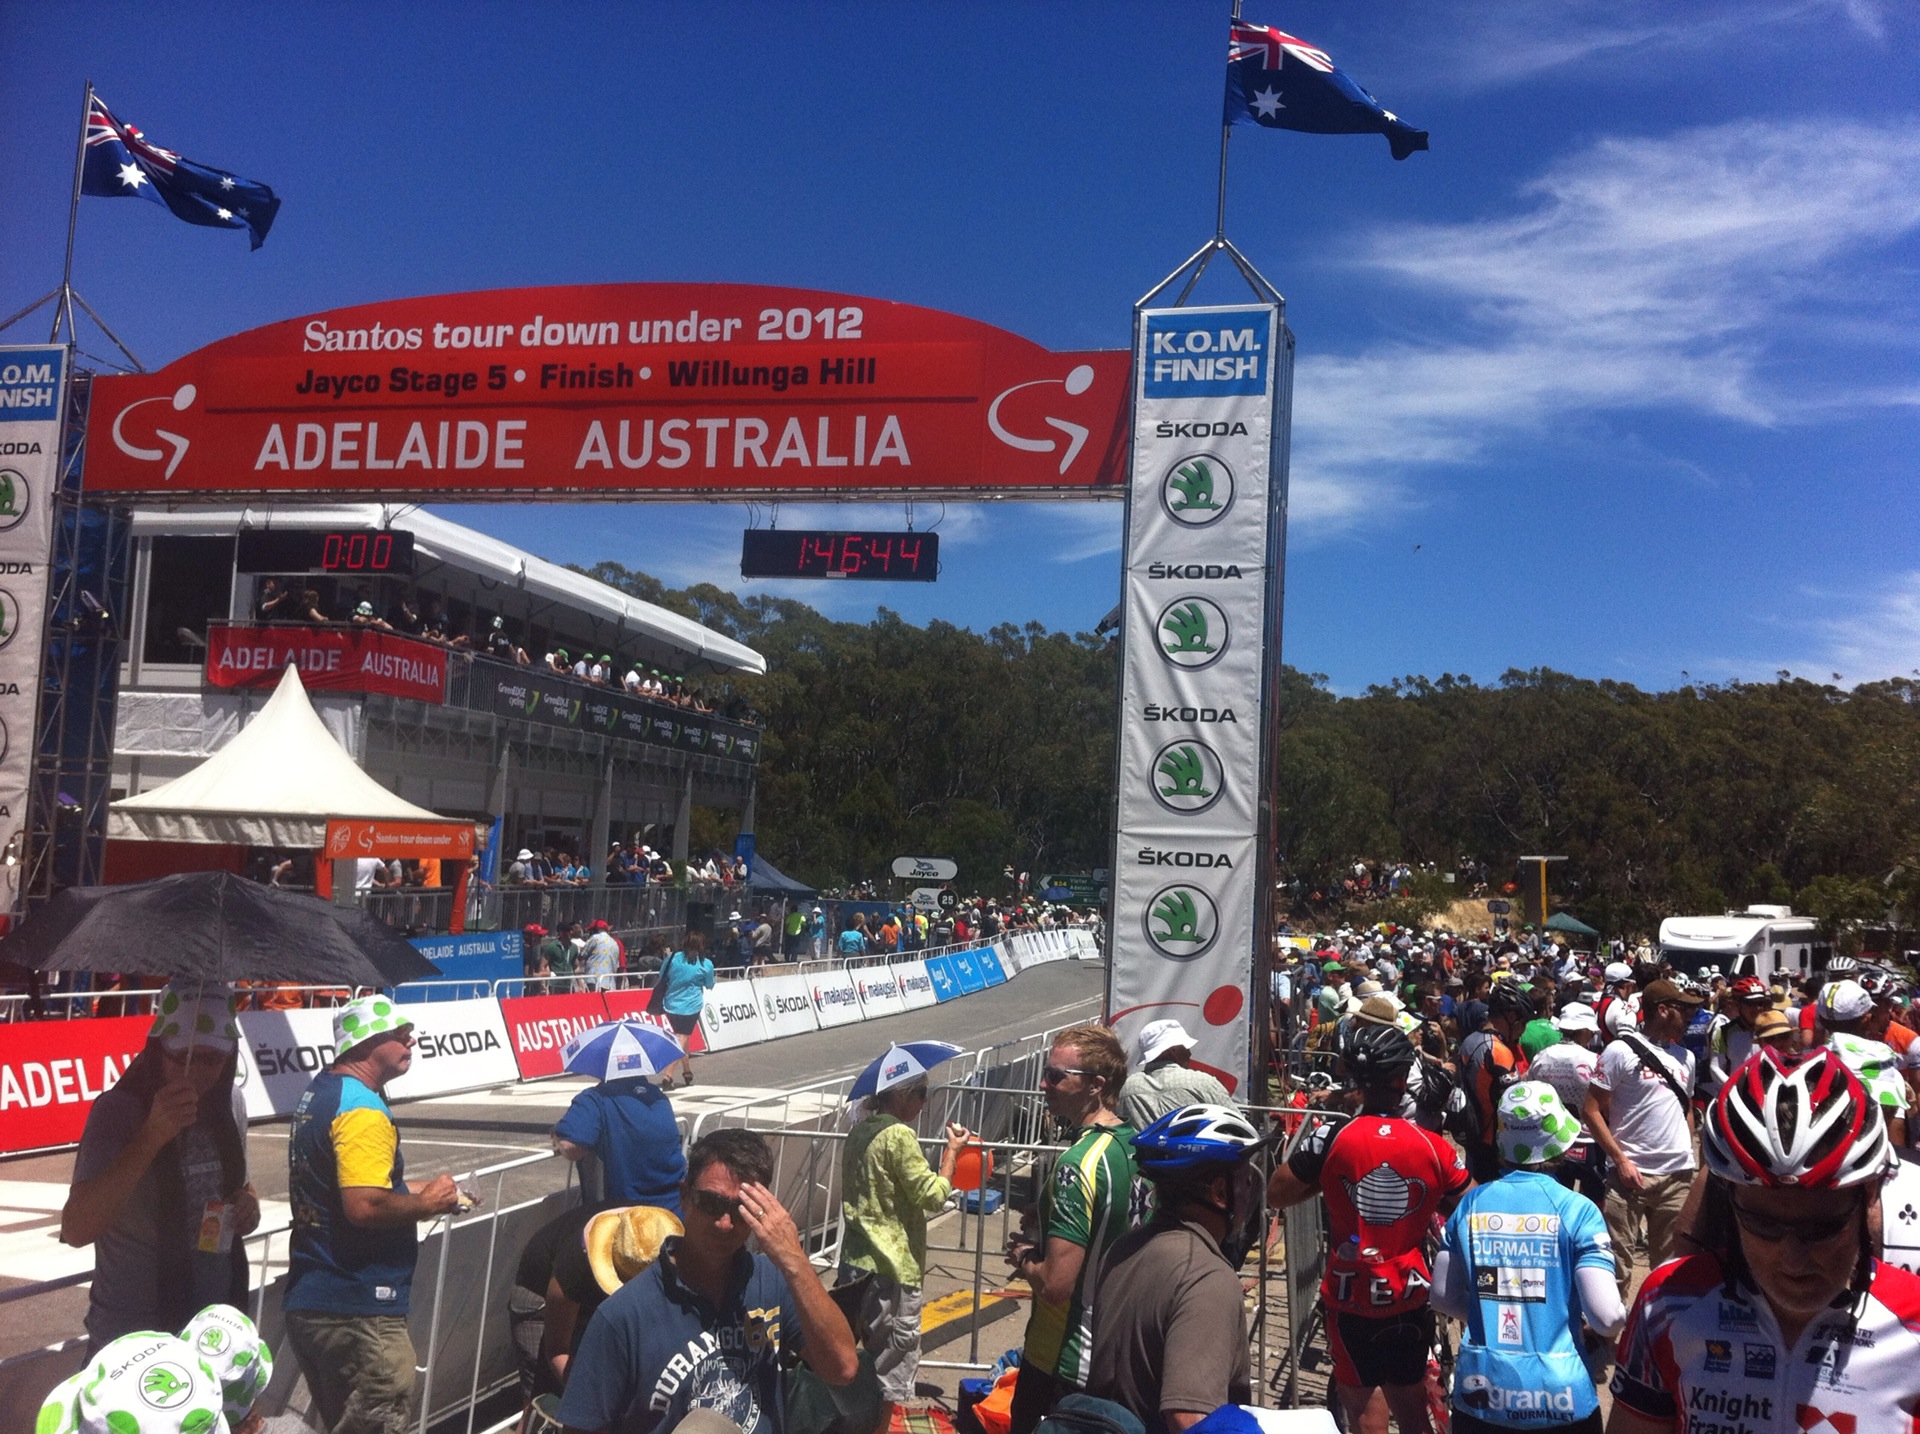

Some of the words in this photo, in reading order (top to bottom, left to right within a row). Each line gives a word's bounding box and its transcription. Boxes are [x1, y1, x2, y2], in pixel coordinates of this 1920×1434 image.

[304, 321, 423, 352] Santos
[433, 322, 514, 348] tour
[520, 315, 619, 347] down
[628, 311, 742, 343] under
[758, 307, 864, 341] 2012
[1154, 328, 1261, 354] K.O.M.
[296, 369, 380, 399] Jayco
[389, 367, 478, 397] Stage
[488, 365, 507, 391] 5
[540, 363, 634, 389] Finish
[668, 360, 809, 392] Willunga
[819, 358, 876, 384] Hill
[1154, 356, 1258, 382] FINISH
[0, 388, 53, 408] NISH
[1156, 420, 1248, 438] ŠKODA
[254, 420, 527, 470] ADELAIDE
[574, 415, 912, 470] AUSTRALIA
[322, 534, 393, 569] 0:00
[798, 535, 922, 573] 1:46:44
[1148, 561, 1242, 580] ŠKODA
[218, 647, 343, 672] ADELAIDE
[360, 651, 439, 688] AUSTRALIA
[1143, 703, 1238, 723] ŠKODA
[1138, 847, 1233, 868] ŠKODA
[910, 869, 939, 877] Jayco
[942, 896, 954, 905] 25
[458, 942, 496, 956] AUSTRALIA
[823, 985, 856, 1005] malaysia
[867, 980, 897, 998] malaysia
[720, 1003, 758, 1024] ŠKODA
[776, 995, 811, 1014] ŠKODA
[417, 1029, 501, 1059] ŠKODA
[255, 1043, 336, 1076] ŠKOD
[1473, 1240, 1558, 1258] OURMALET
[1333, 1268, 1431, 1305] TEA
[1488, 1386, 1574, 1411] grand
[1690, 1386, 1773, 1421] Knight
[1506, 1410, 1575, 1422] TOURMALET
